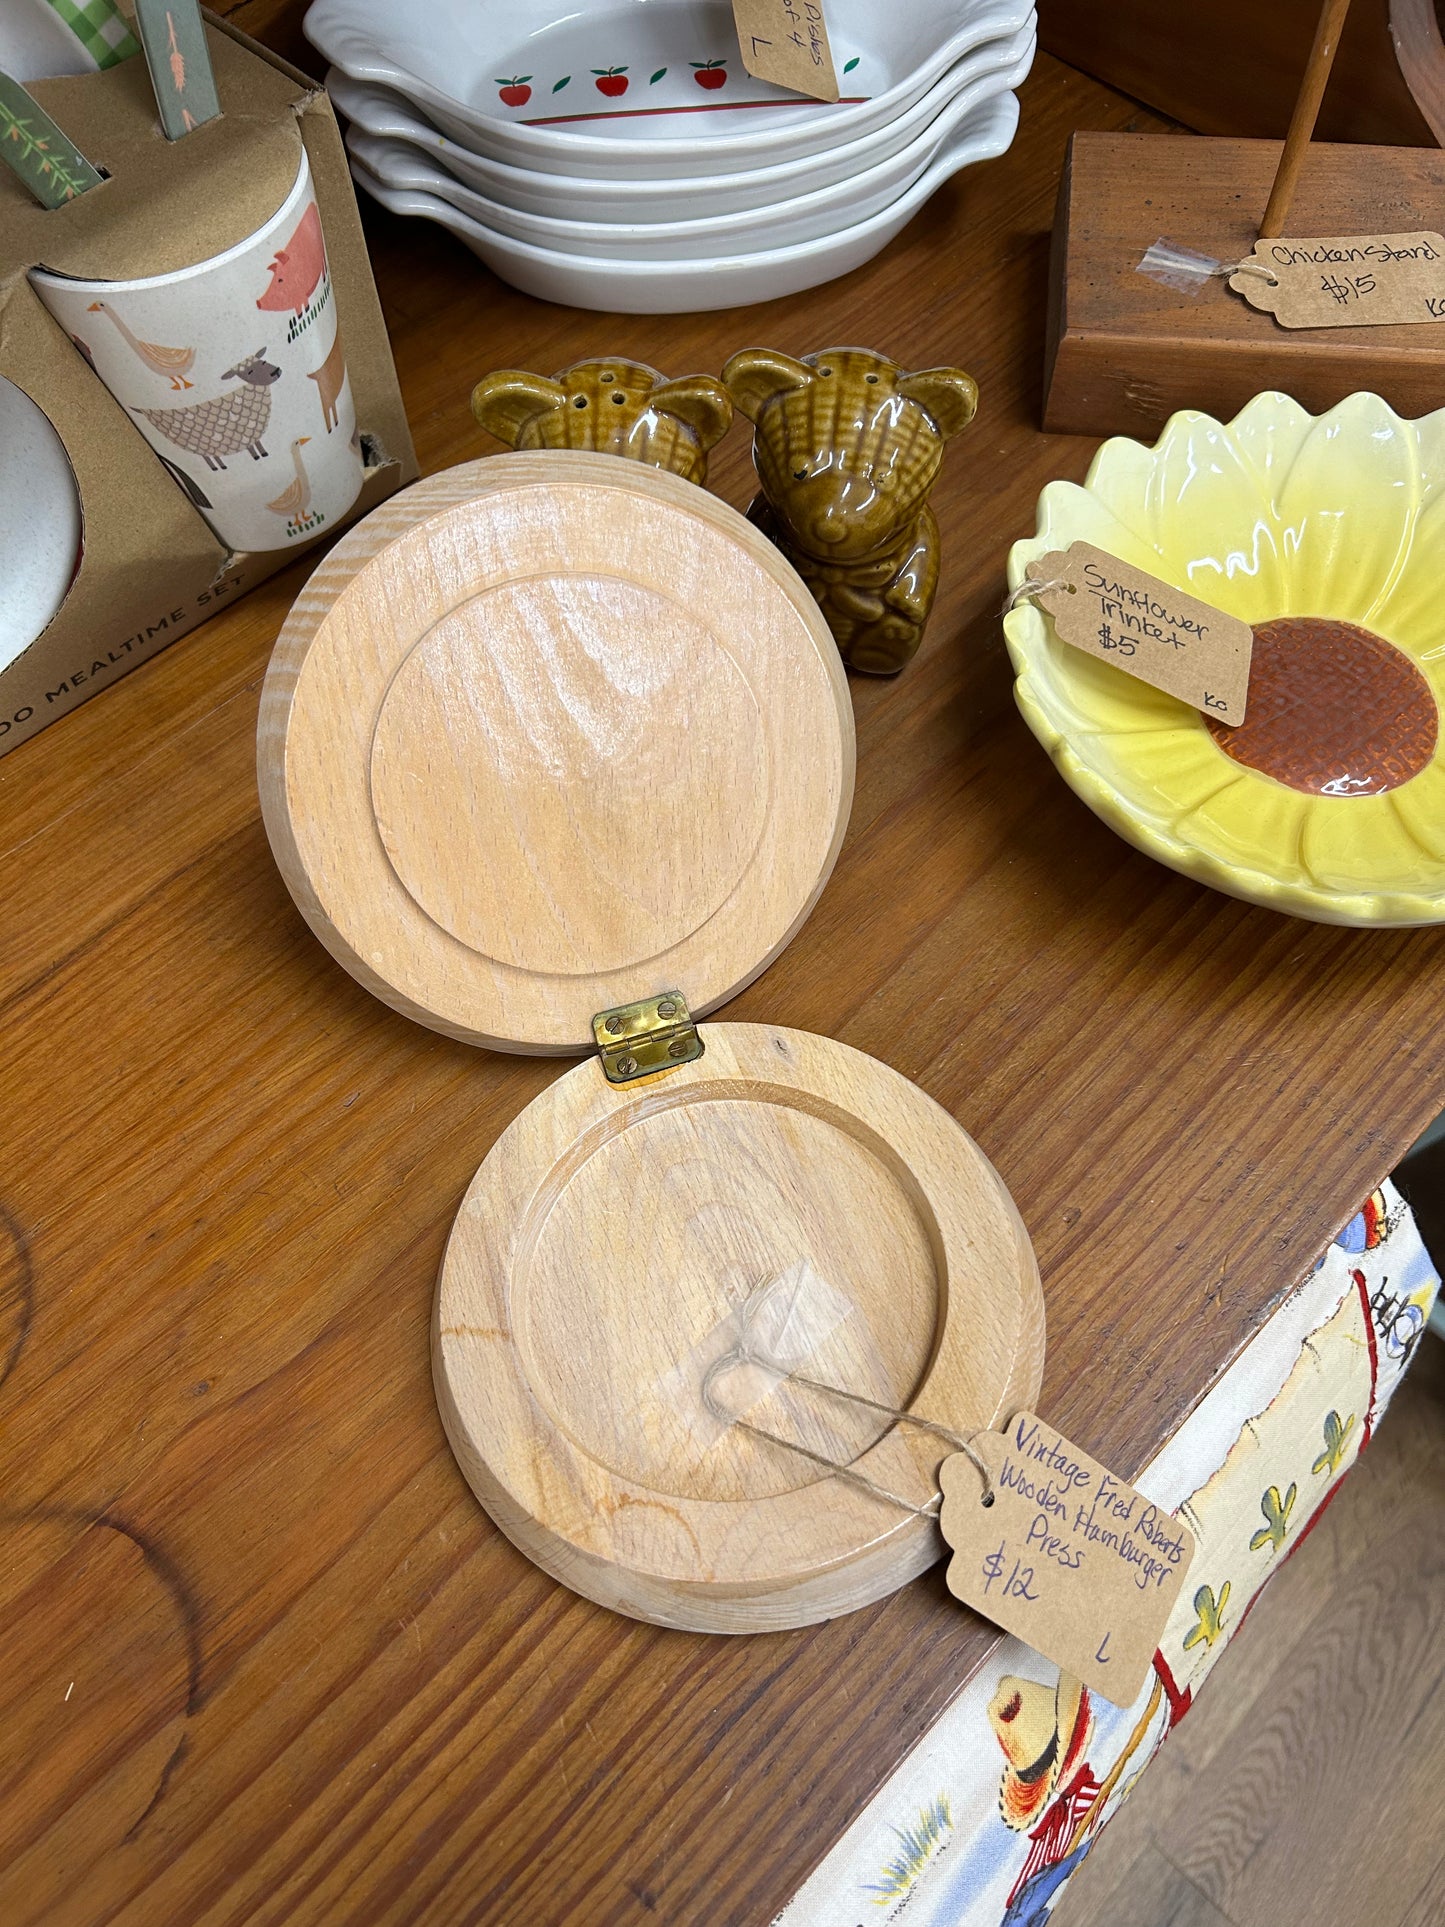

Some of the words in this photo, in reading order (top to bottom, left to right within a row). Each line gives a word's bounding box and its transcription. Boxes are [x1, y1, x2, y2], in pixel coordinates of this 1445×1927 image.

[751, 36, 773, 57] L
[786, 31, 807, 48] 4
[1320, 273, 1377, 304] $15
[1084, 564, 1210, 640] Sunflower
[1088, 590, 1186, 649] Trinket
[45, 607, 187, 704] MEALTIME
[196, 574, 246, 606] SET
[1097, 623, 1140, 656] $5
[1015, 1418, 1091, 1494] Vintage
[1094, 1474, 1138, 1521] Fred
[1133, 1505, 1186, 1564] Roberts
[1000, 1456, 1067, 1521] Wooden
[1072, 1503, 1173, 1590] Hamburger
[1026, 1513, 1086, 1570] Press
[982, 1540, 1040, 1601] $12
[1095, 1631, 1111, 1663] L
